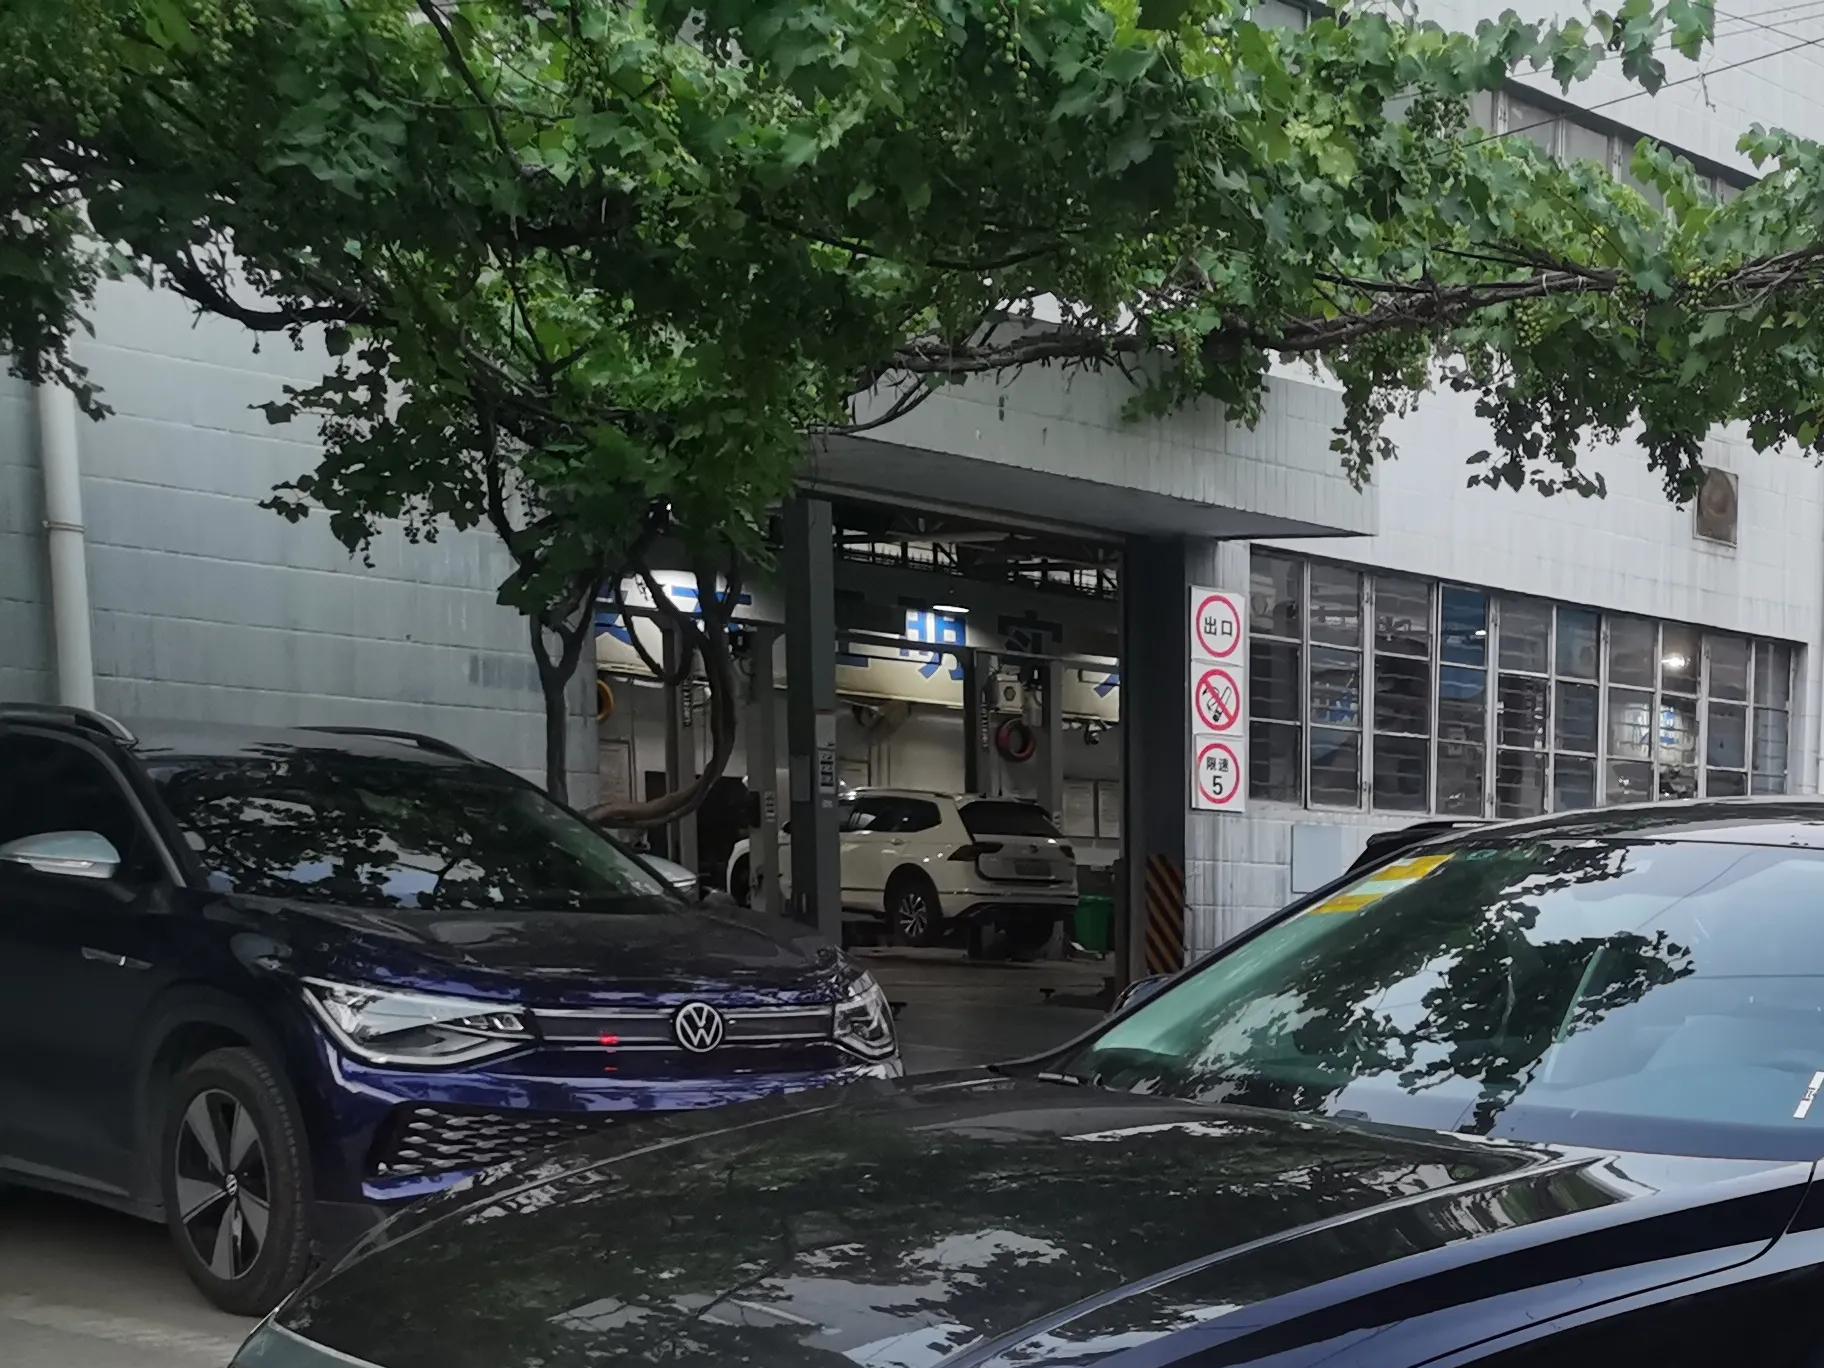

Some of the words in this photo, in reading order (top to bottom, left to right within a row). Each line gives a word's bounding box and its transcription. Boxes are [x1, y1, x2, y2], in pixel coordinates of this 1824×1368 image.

[1204, 615, 1234, 637] 出口
[1206, 756, 1230, 773] 限速
[1212, 775, 1224, 796] 5
